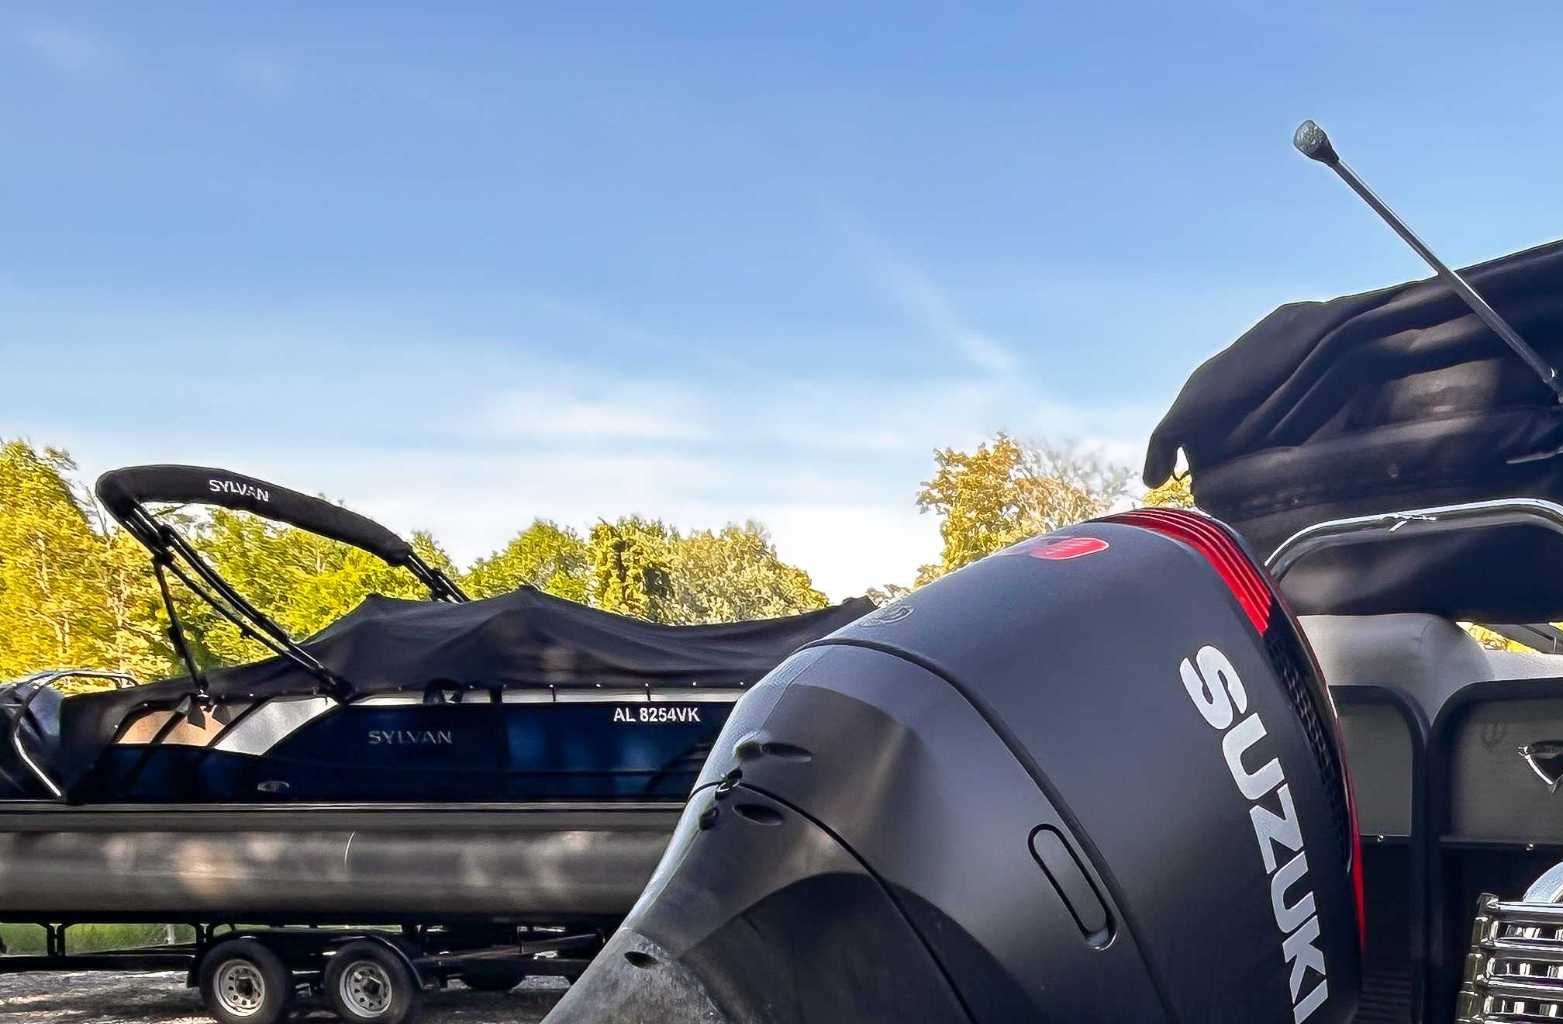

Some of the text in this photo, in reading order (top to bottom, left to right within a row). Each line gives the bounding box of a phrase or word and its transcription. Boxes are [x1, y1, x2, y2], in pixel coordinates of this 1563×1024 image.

[209, 479, 269, 502] SYLVAN
[613, 707, 637, 722] AL
[368, 729, 453, 744] SYLVAN
